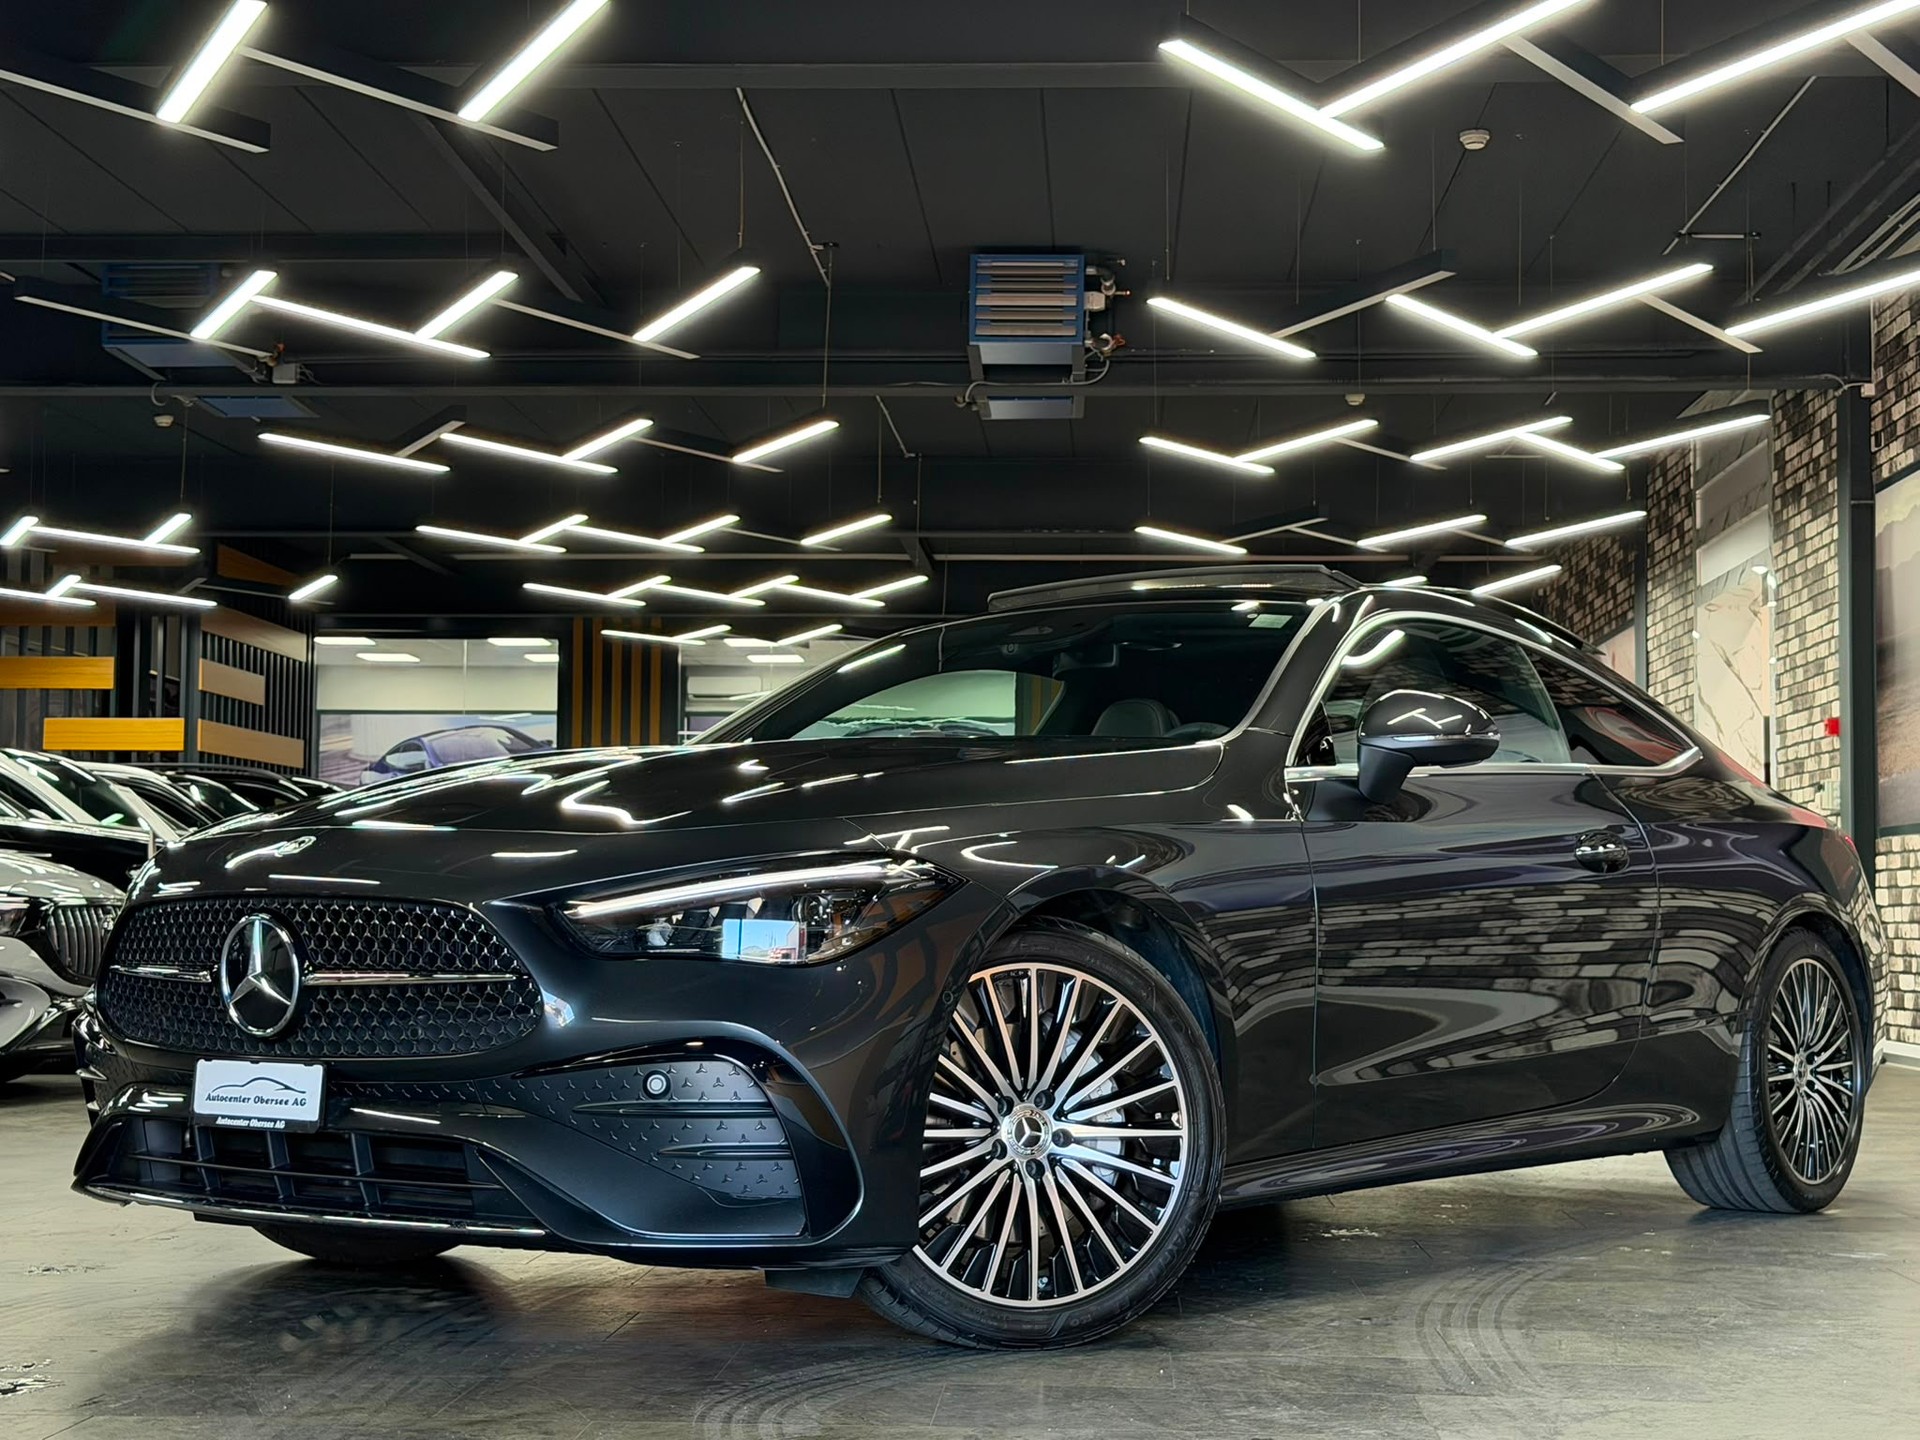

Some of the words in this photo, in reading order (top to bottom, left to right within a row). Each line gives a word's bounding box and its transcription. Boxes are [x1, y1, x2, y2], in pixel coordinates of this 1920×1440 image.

[205, 1092, 251, 1104] Autocenter
[253, 1095, 289, 1106] Obersee
[291, 1097, 307, 1107] AG
[216, 1116, 249, 1127] Autocenter
[249, 1119, 275, 1128] Obersee
[275, 1120, 286, 1129] AG
